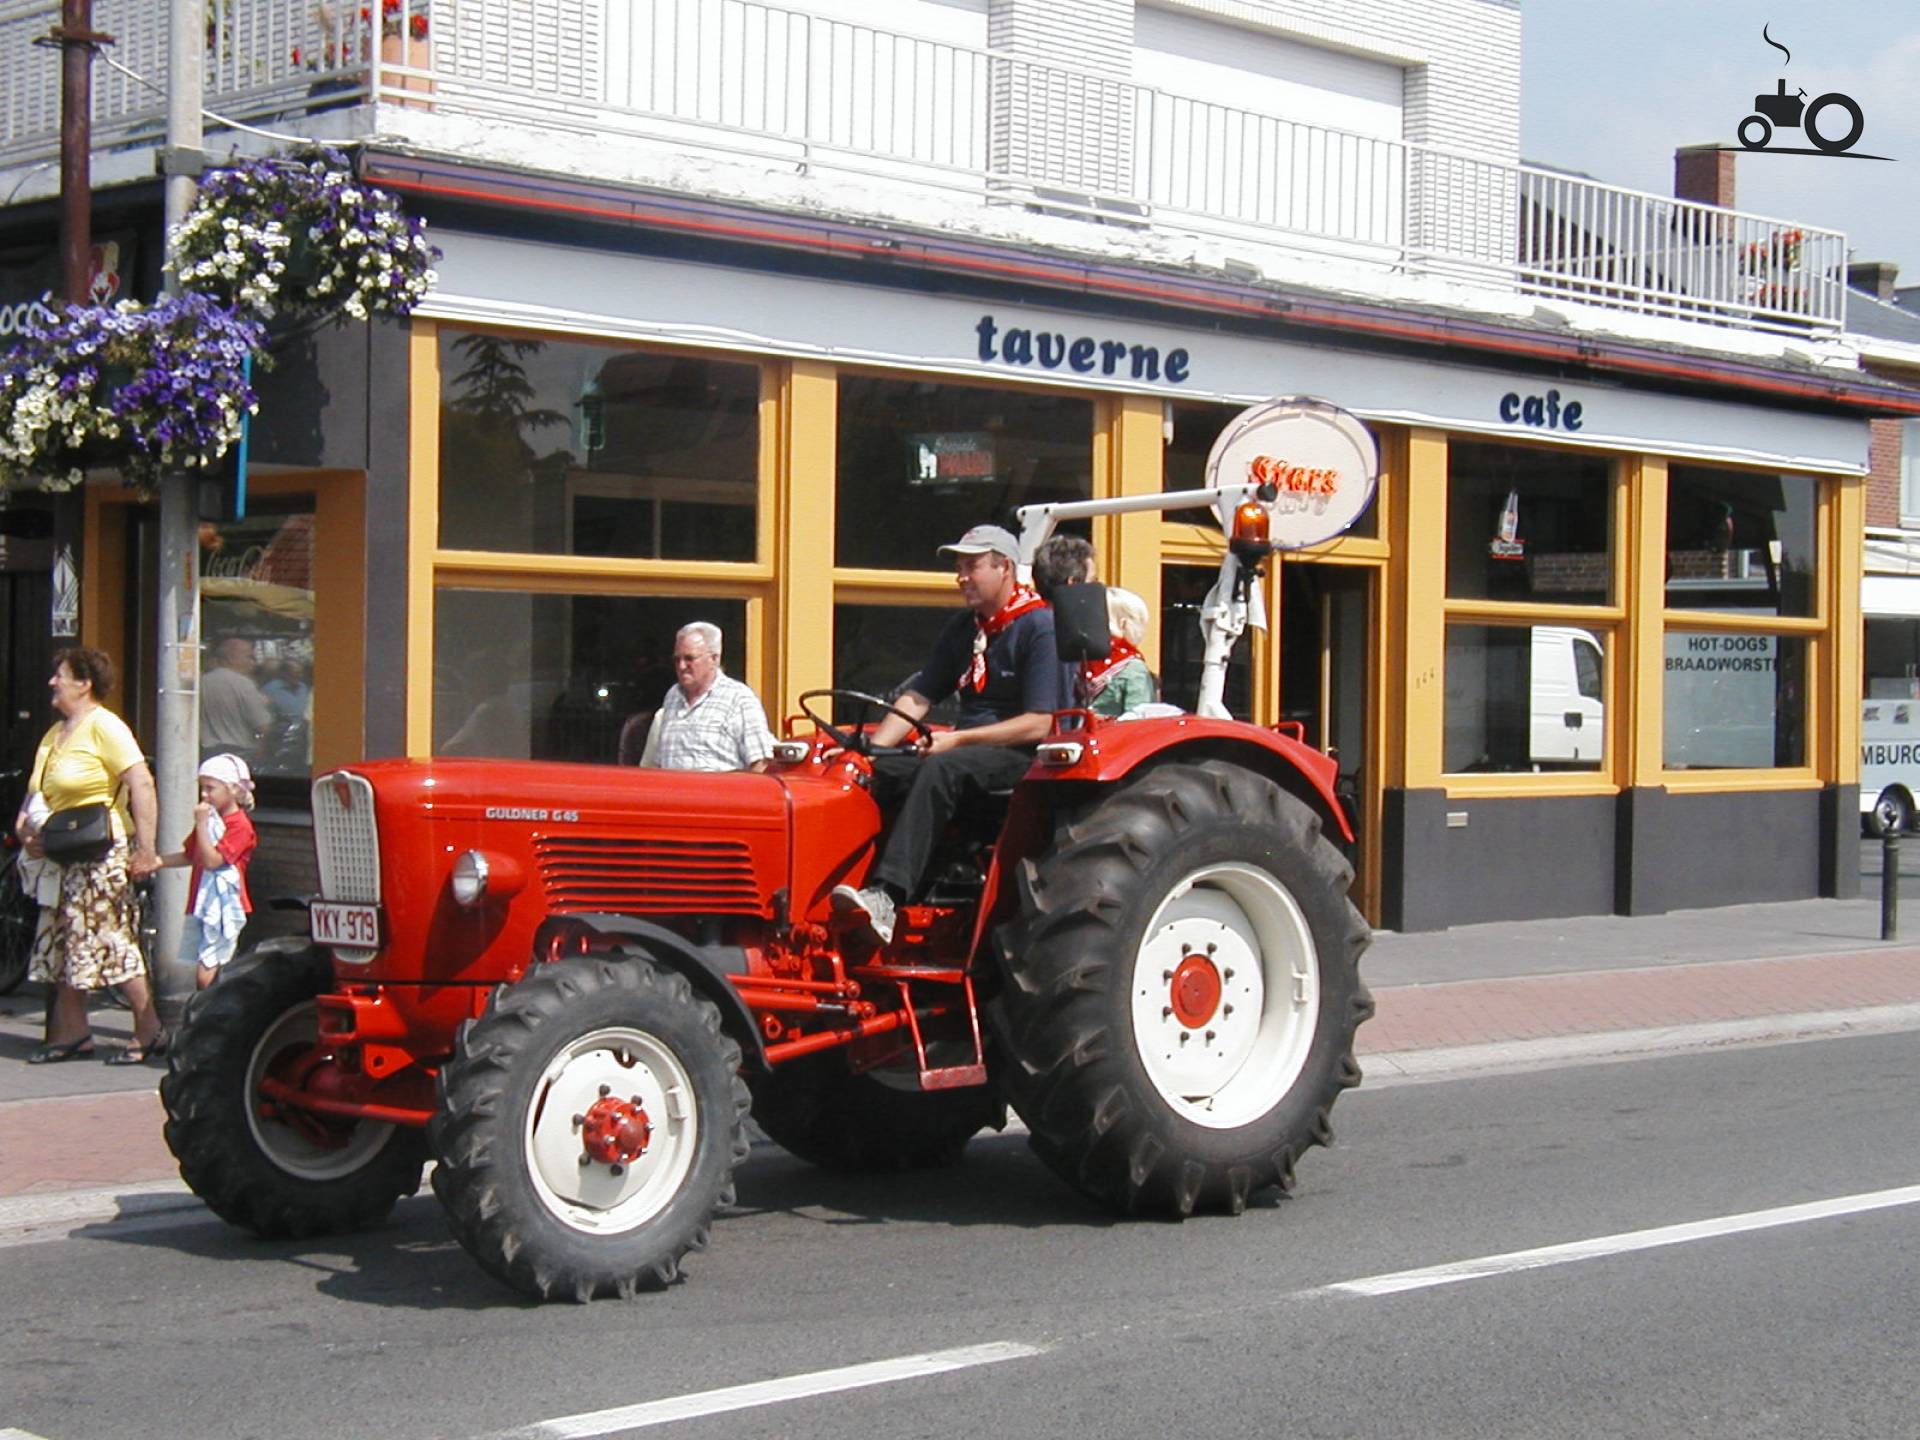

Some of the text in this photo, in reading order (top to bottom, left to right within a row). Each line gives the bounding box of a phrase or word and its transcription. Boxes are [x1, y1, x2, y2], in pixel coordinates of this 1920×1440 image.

[976, 315, 1189, 382] taverne
[1500, 389, 1583, 431] cafe
[1688, 637, 1768, 652] HOT-DOGS
